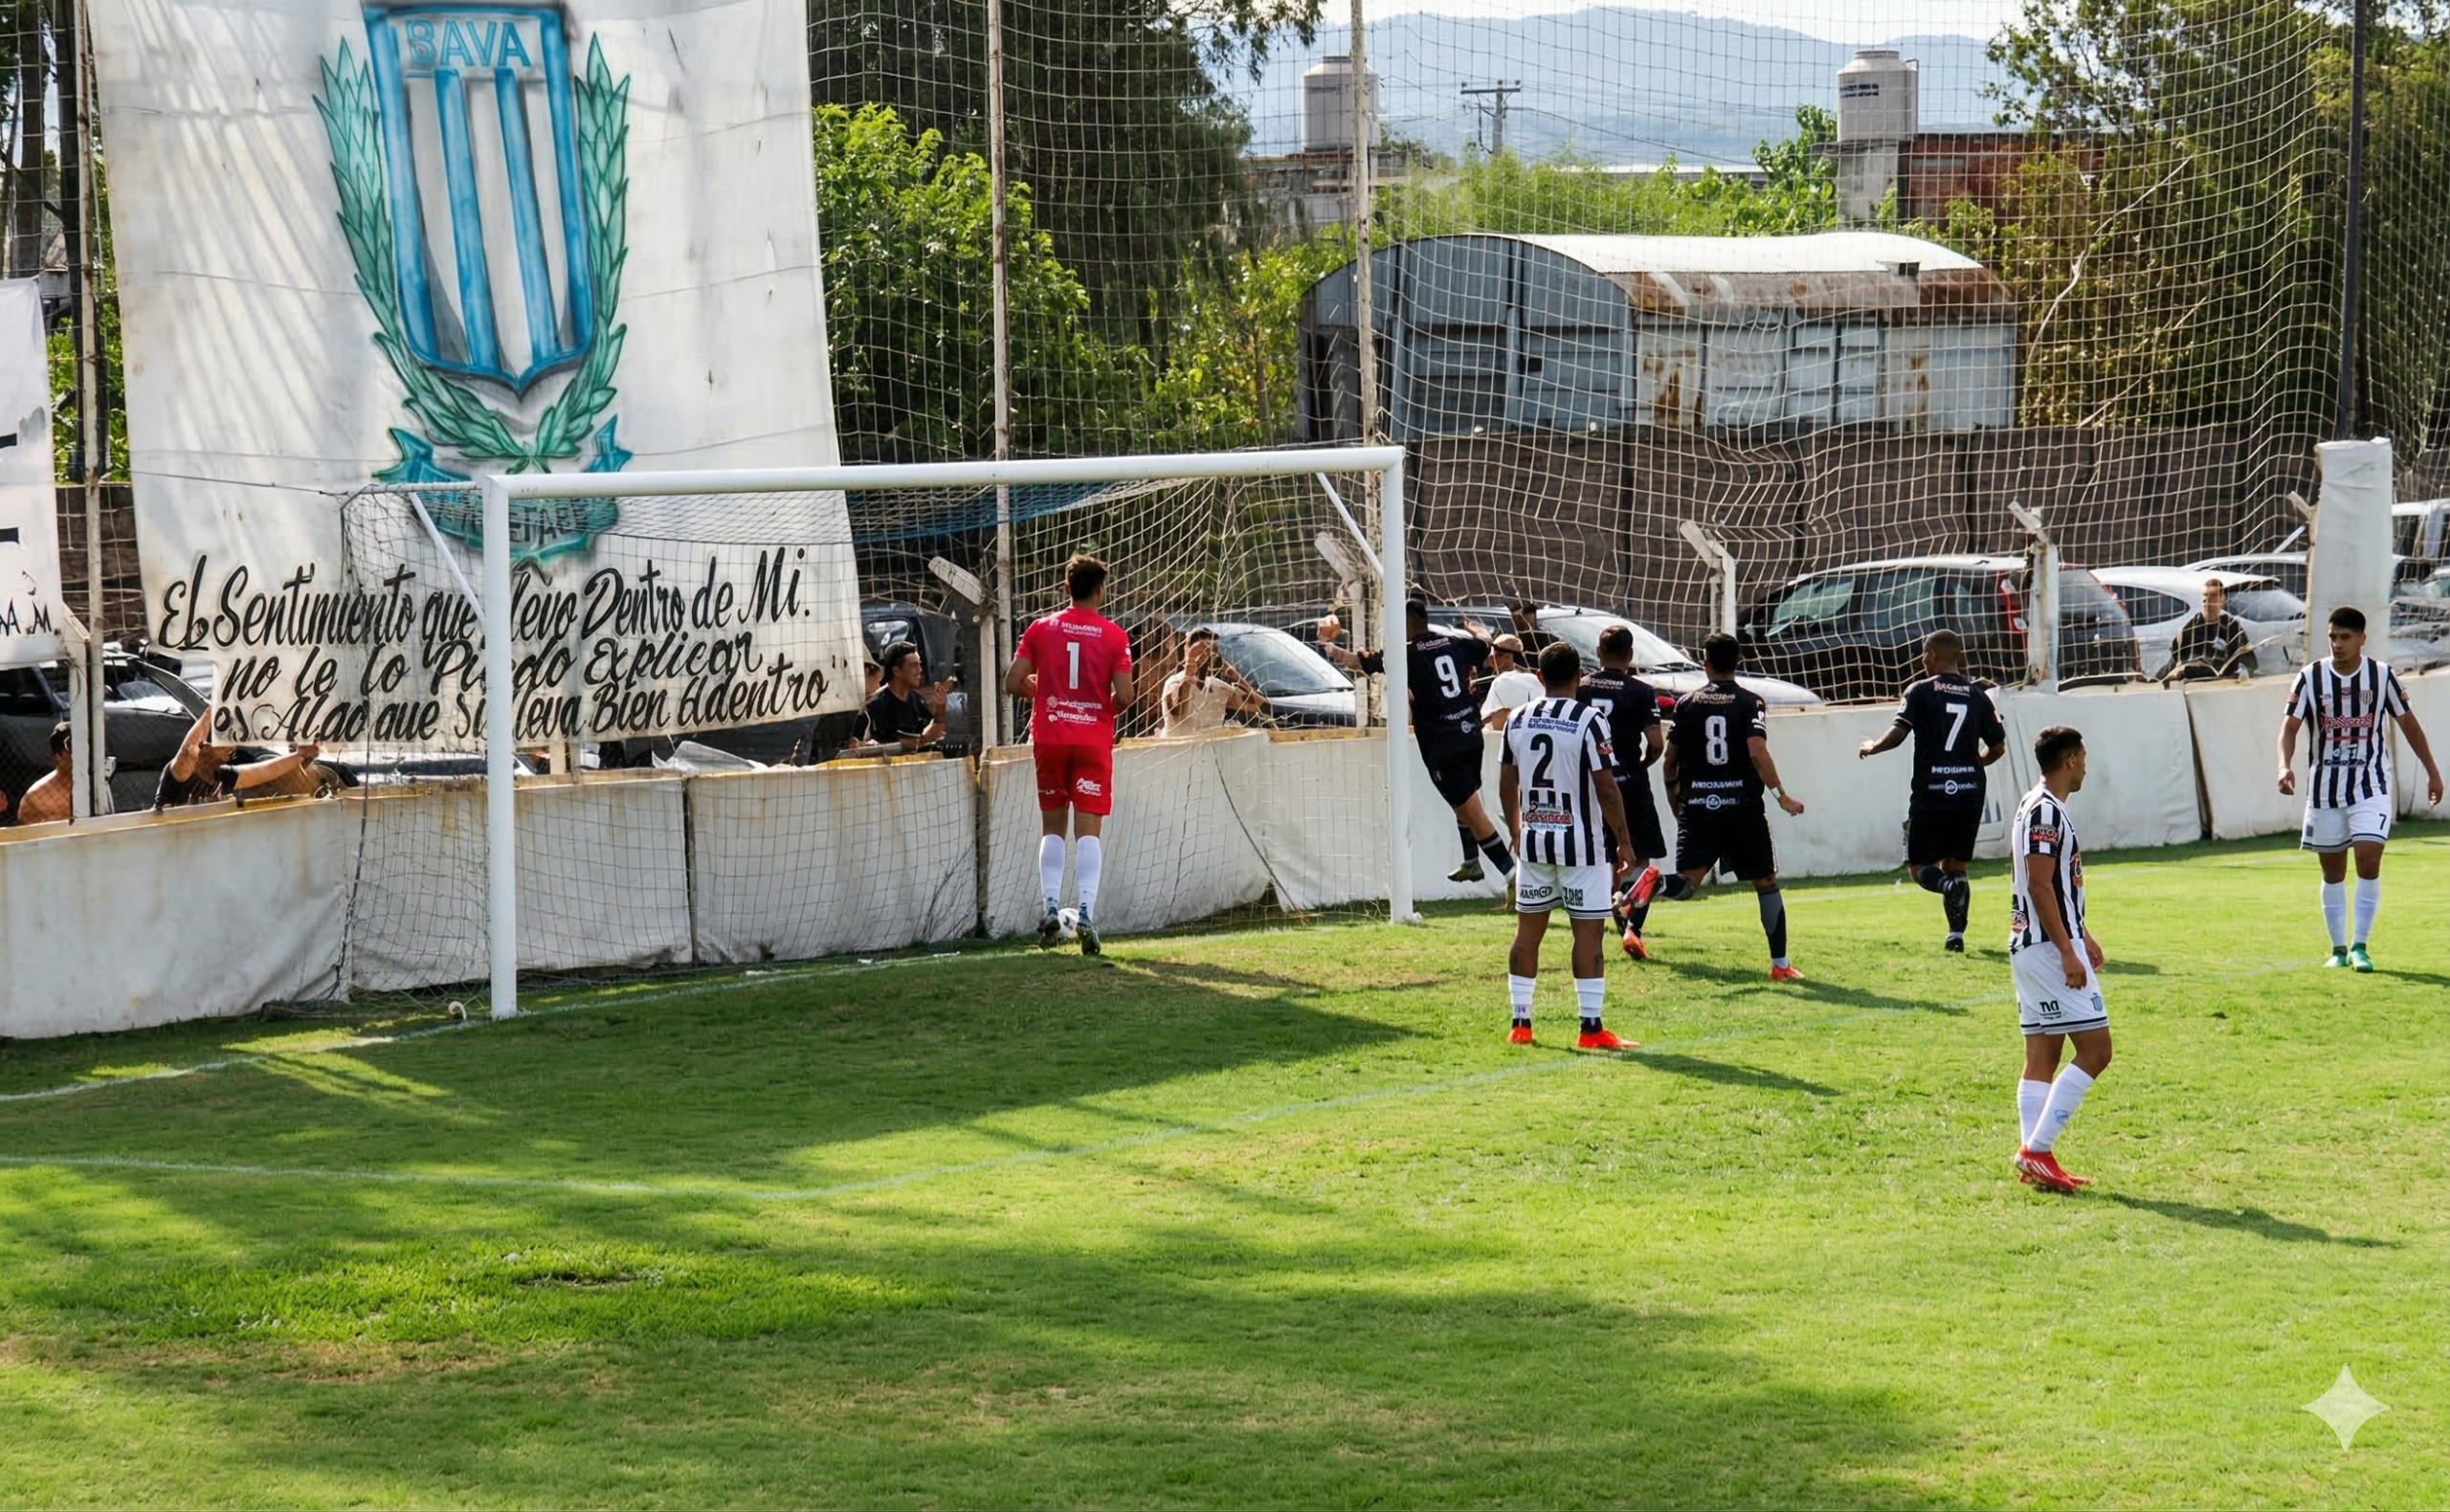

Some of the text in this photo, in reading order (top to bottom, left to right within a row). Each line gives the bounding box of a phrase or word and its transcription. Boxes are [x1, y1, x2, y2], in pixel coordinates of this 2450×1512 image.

[405, 19, 531, 67] BAVA
[581, 559, 685, 639] Dentro
[692, 556, 734, 630] de
[221, 656, 281, 702] no
[431, 636, 577, 696] Pudo
[1066, 641, 1080, 690] 1
[1435, 655, 1460, 699] 9
[590, 680, 671, 733] Bien
[1946, 702, 1968, 751] 7
[1529, 733, 1554, 789] 2
[1704, 715, 1728, 766] 8
[2379, 813, 2387, 831] 7
